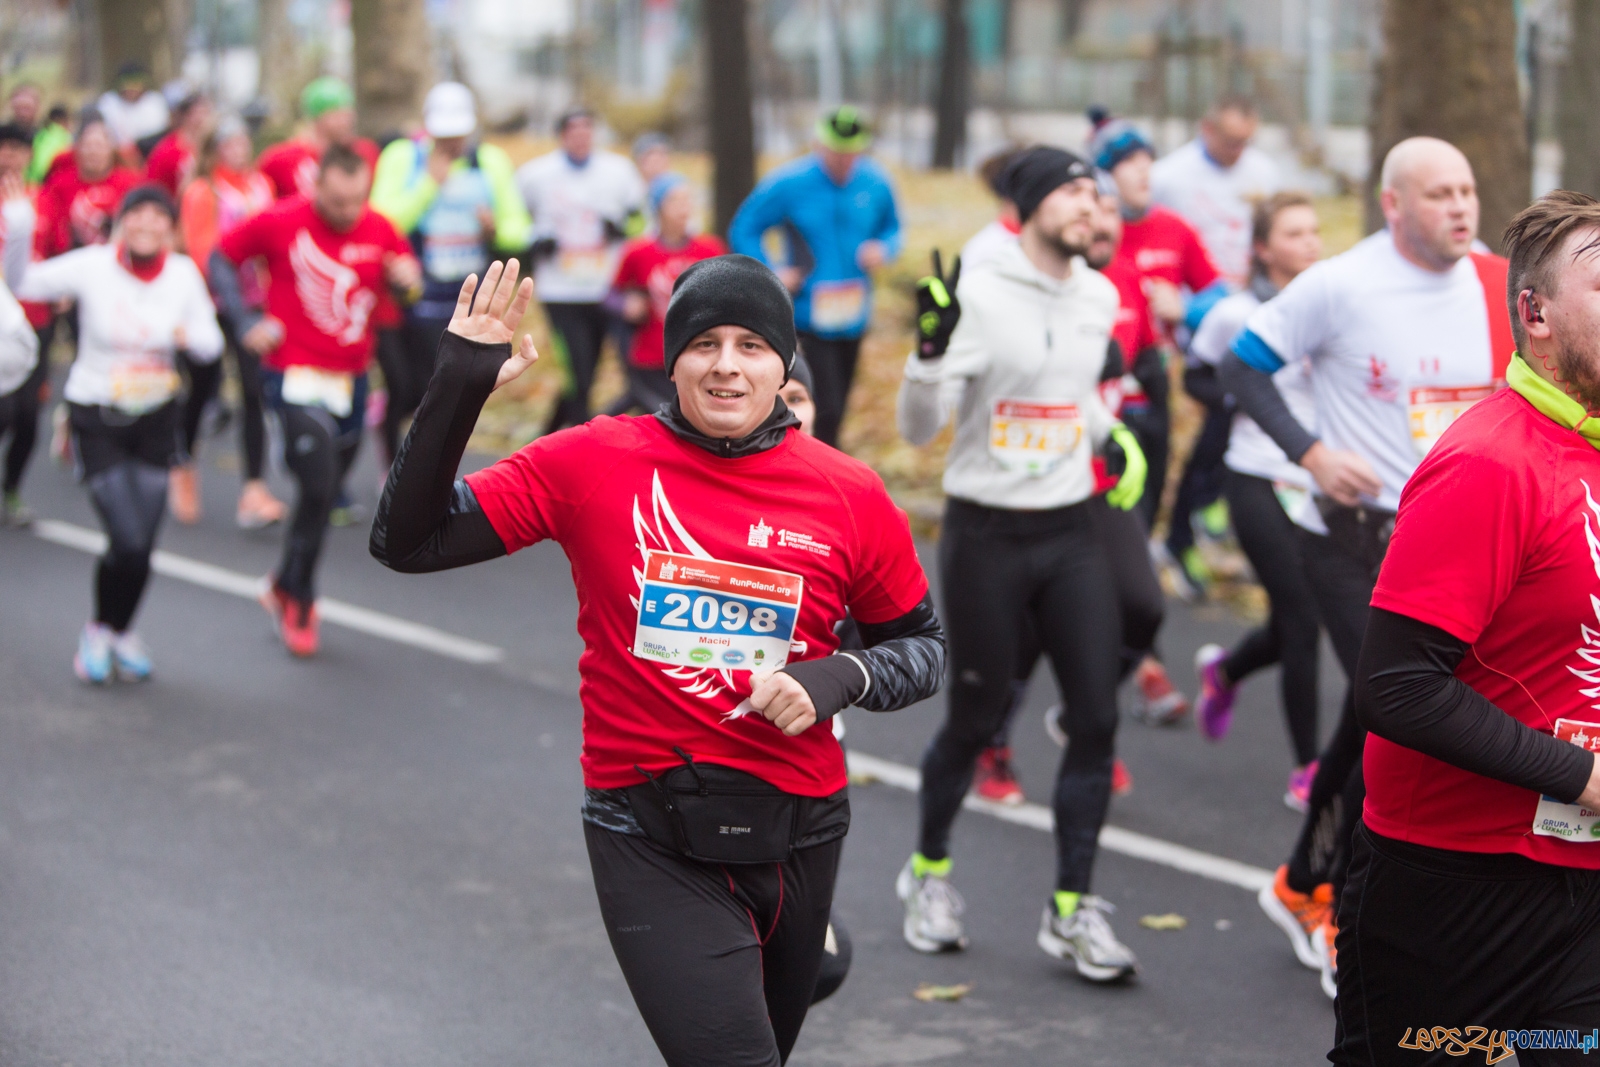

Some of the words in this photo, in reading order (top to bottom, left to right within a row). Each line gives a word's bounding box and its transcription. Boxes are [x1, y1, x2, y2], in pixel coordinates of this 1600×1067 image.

[777, 528, 787, 547] 1
[679, 565, 687, 580] 1
[729, 577, 791, 597] RunPoland.org
[645, 599, 657, 614] E
[660, 592, 778, 633] 2098
[643, 641, 667, 652] GRUPA
[698, 636, 731, 647] Maciej
[642, 647, 671, 659] LUXMED
[1542, 818, 1569, 829] GRUPA
[1541, 824, 1573, 837] LUXMED
